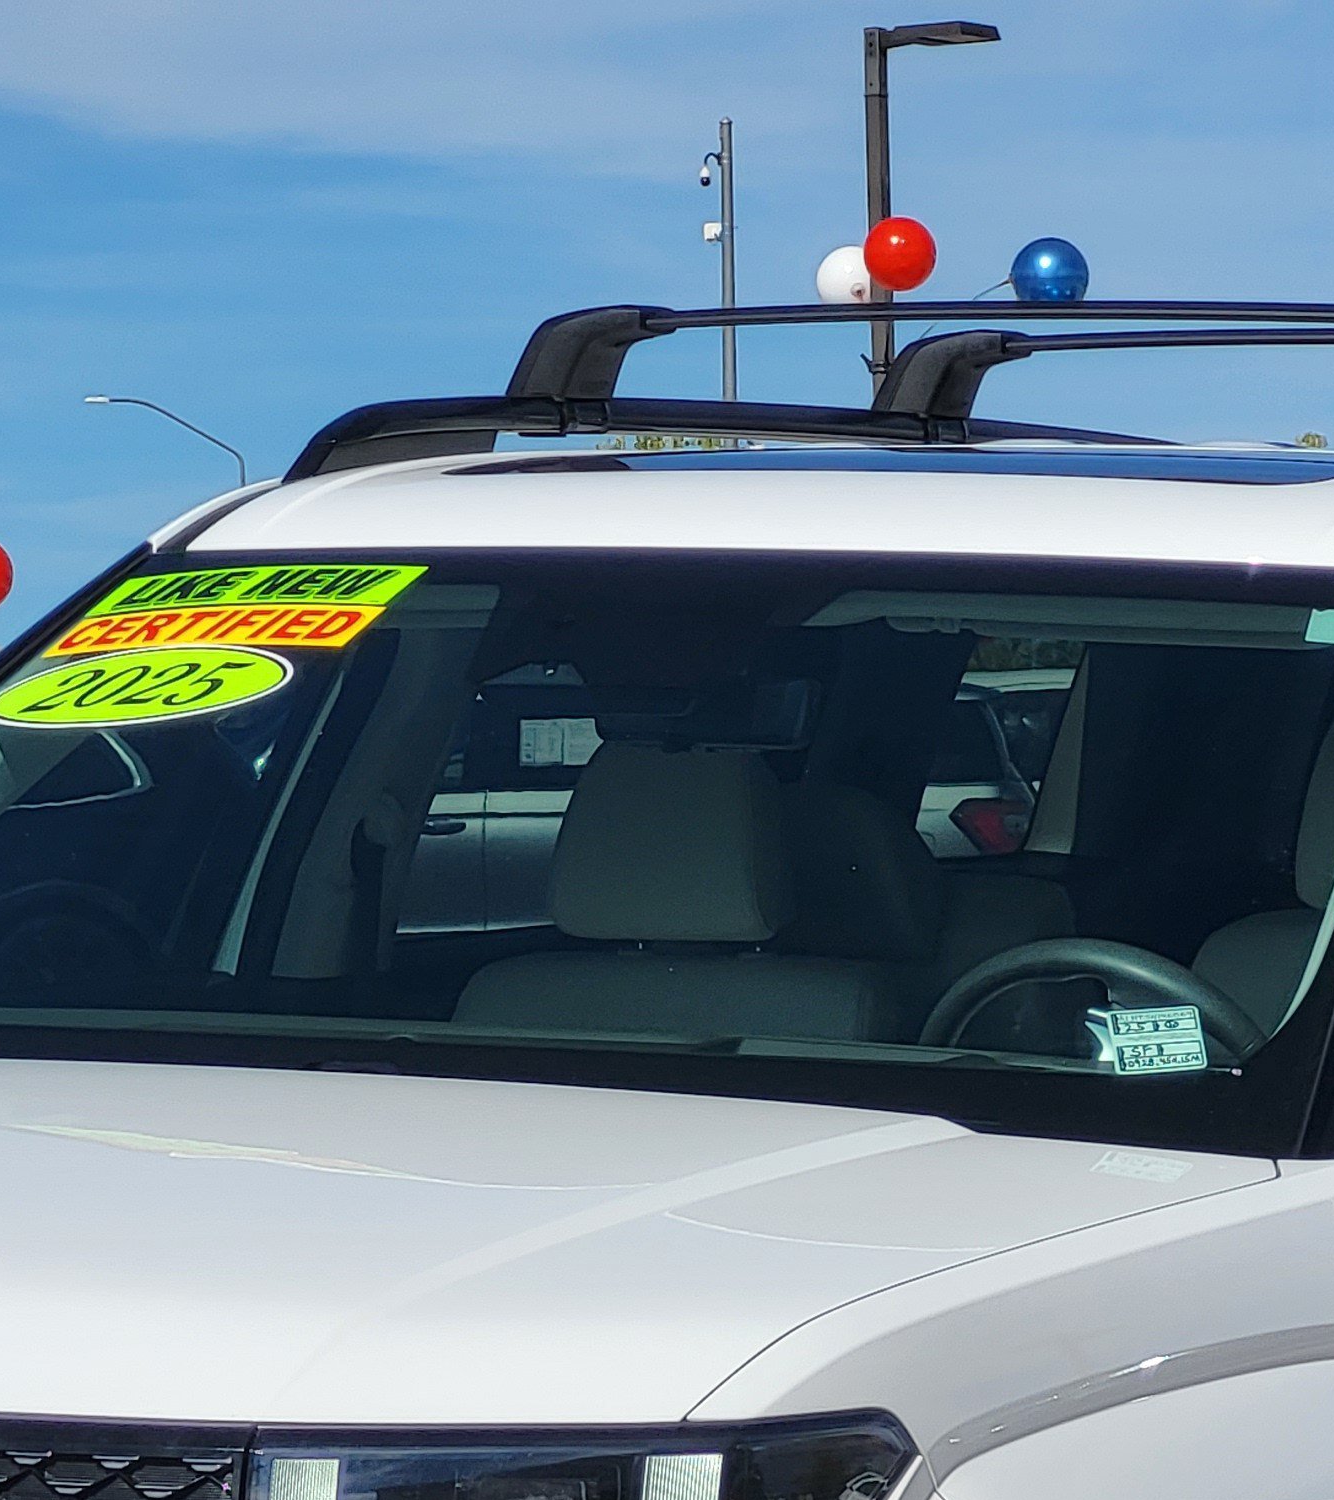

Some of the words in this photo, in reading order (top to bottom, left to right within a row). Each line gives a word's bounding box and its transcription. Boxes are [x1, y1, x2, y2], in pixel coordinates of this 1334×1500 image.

[111, 570, 259, 611] LIKE
[237, 568, 401, 600] NEW
[58, 609, 363, 650] CERTIFIED
[17, 662, 256, 714] 2025
